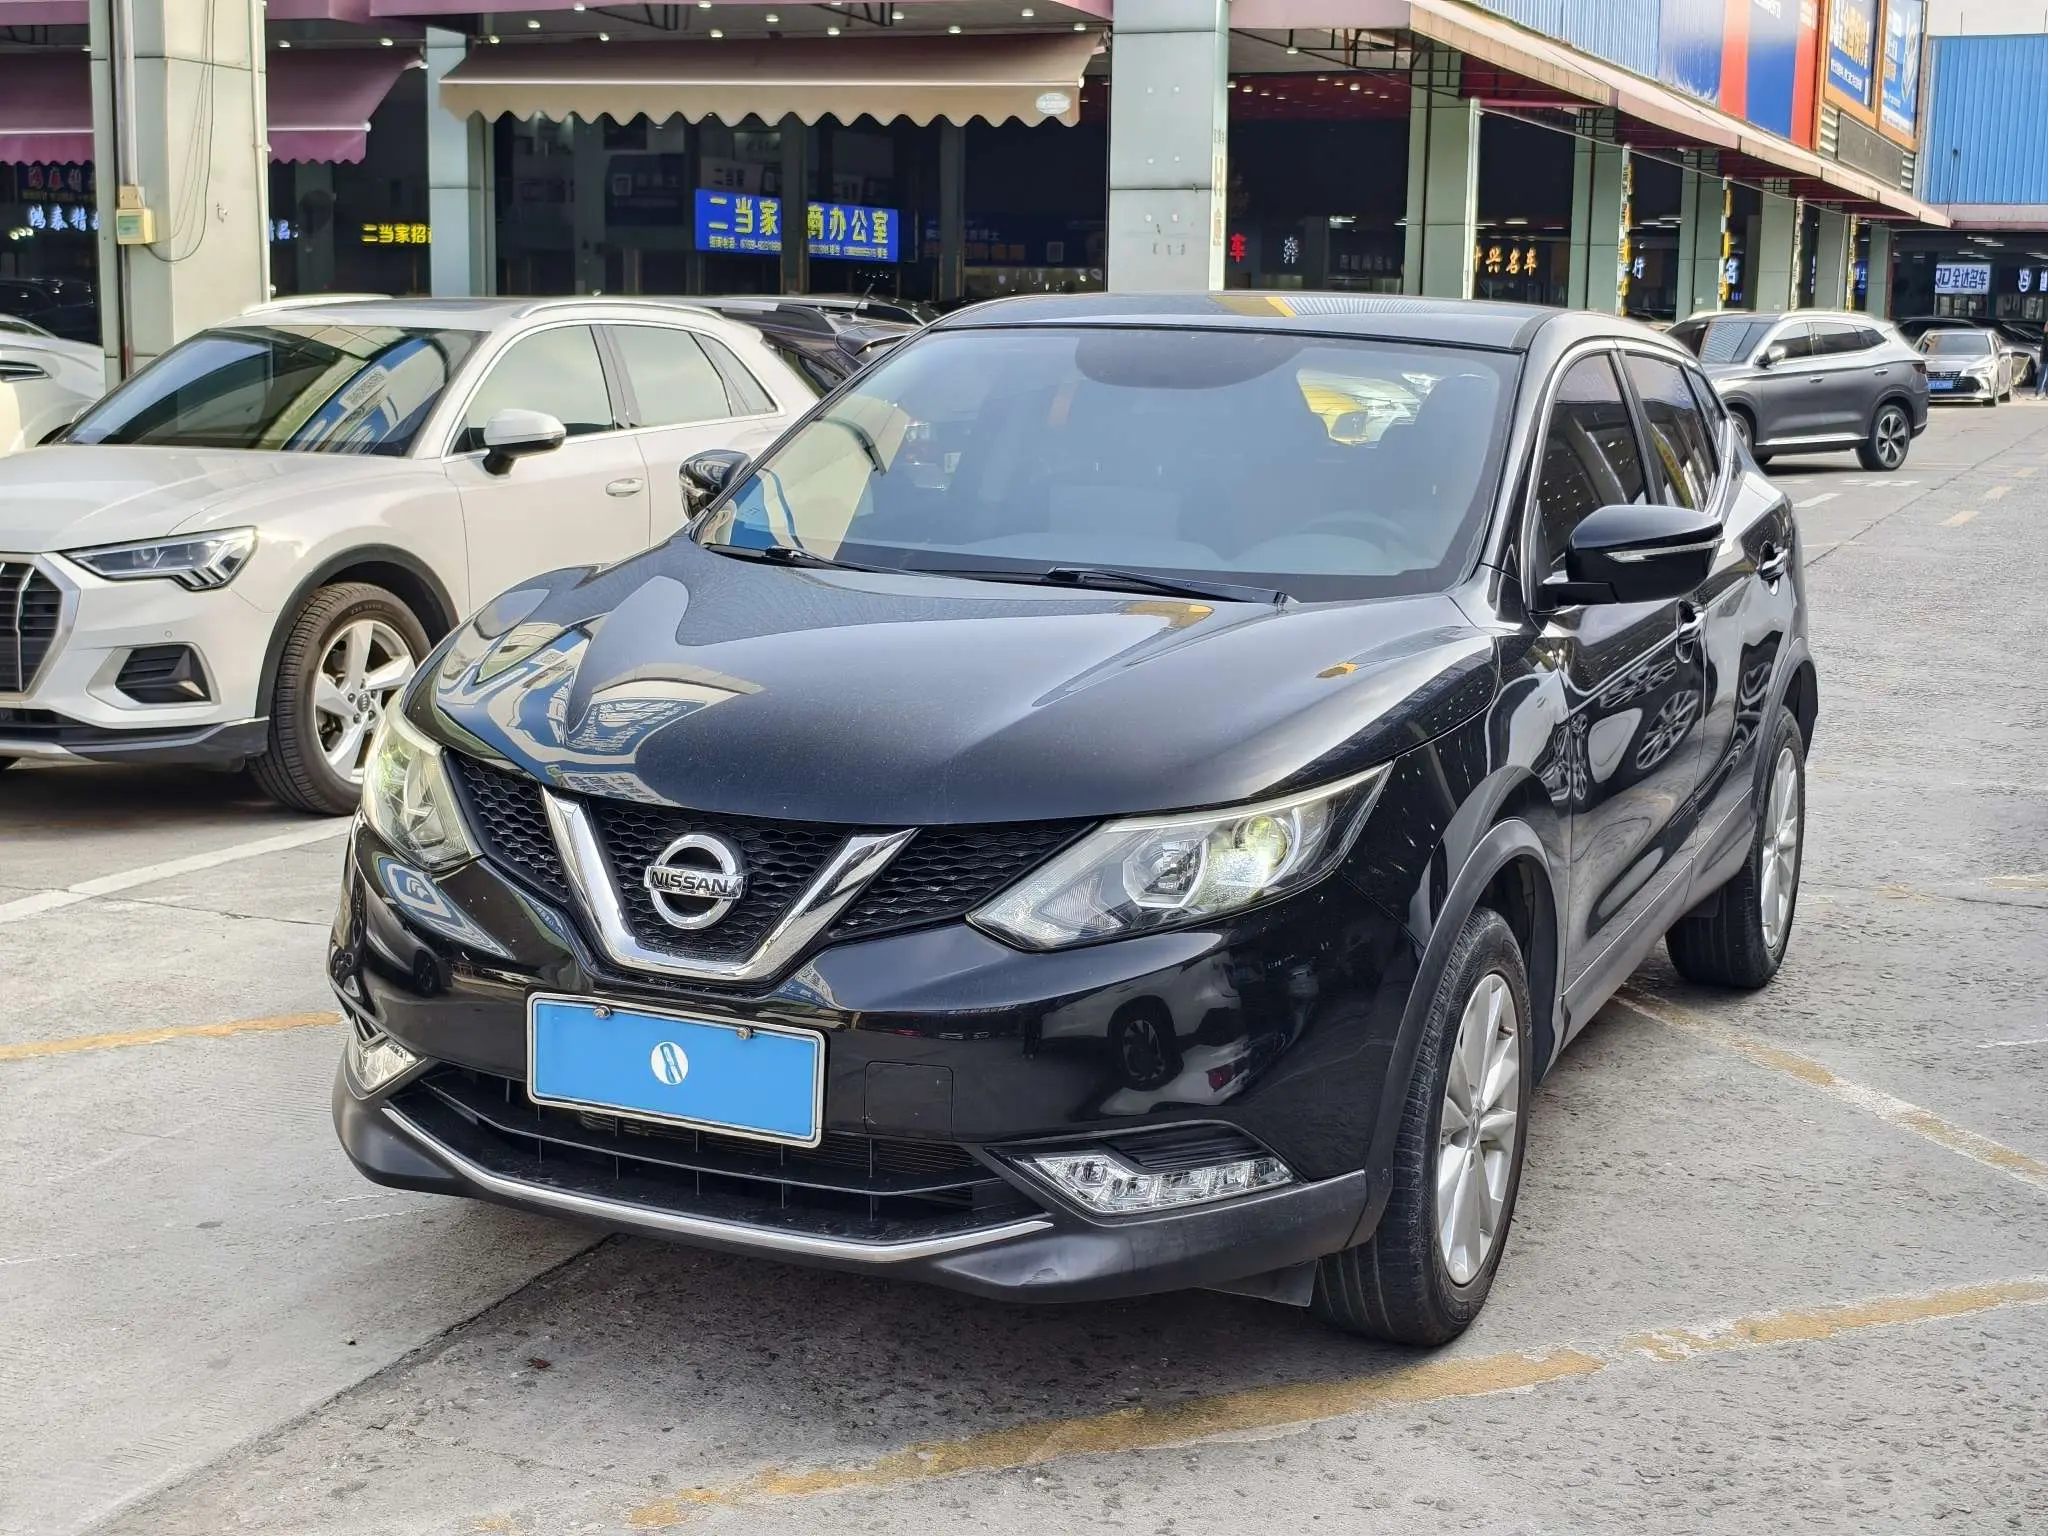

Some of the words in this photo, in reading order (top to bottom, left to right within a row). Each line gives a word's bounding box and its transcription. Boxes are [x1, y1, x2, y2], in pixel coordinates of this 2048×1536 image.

[361, 222, 432, 245] 二当家招
[651, 871, 729, 893] NISSAN
